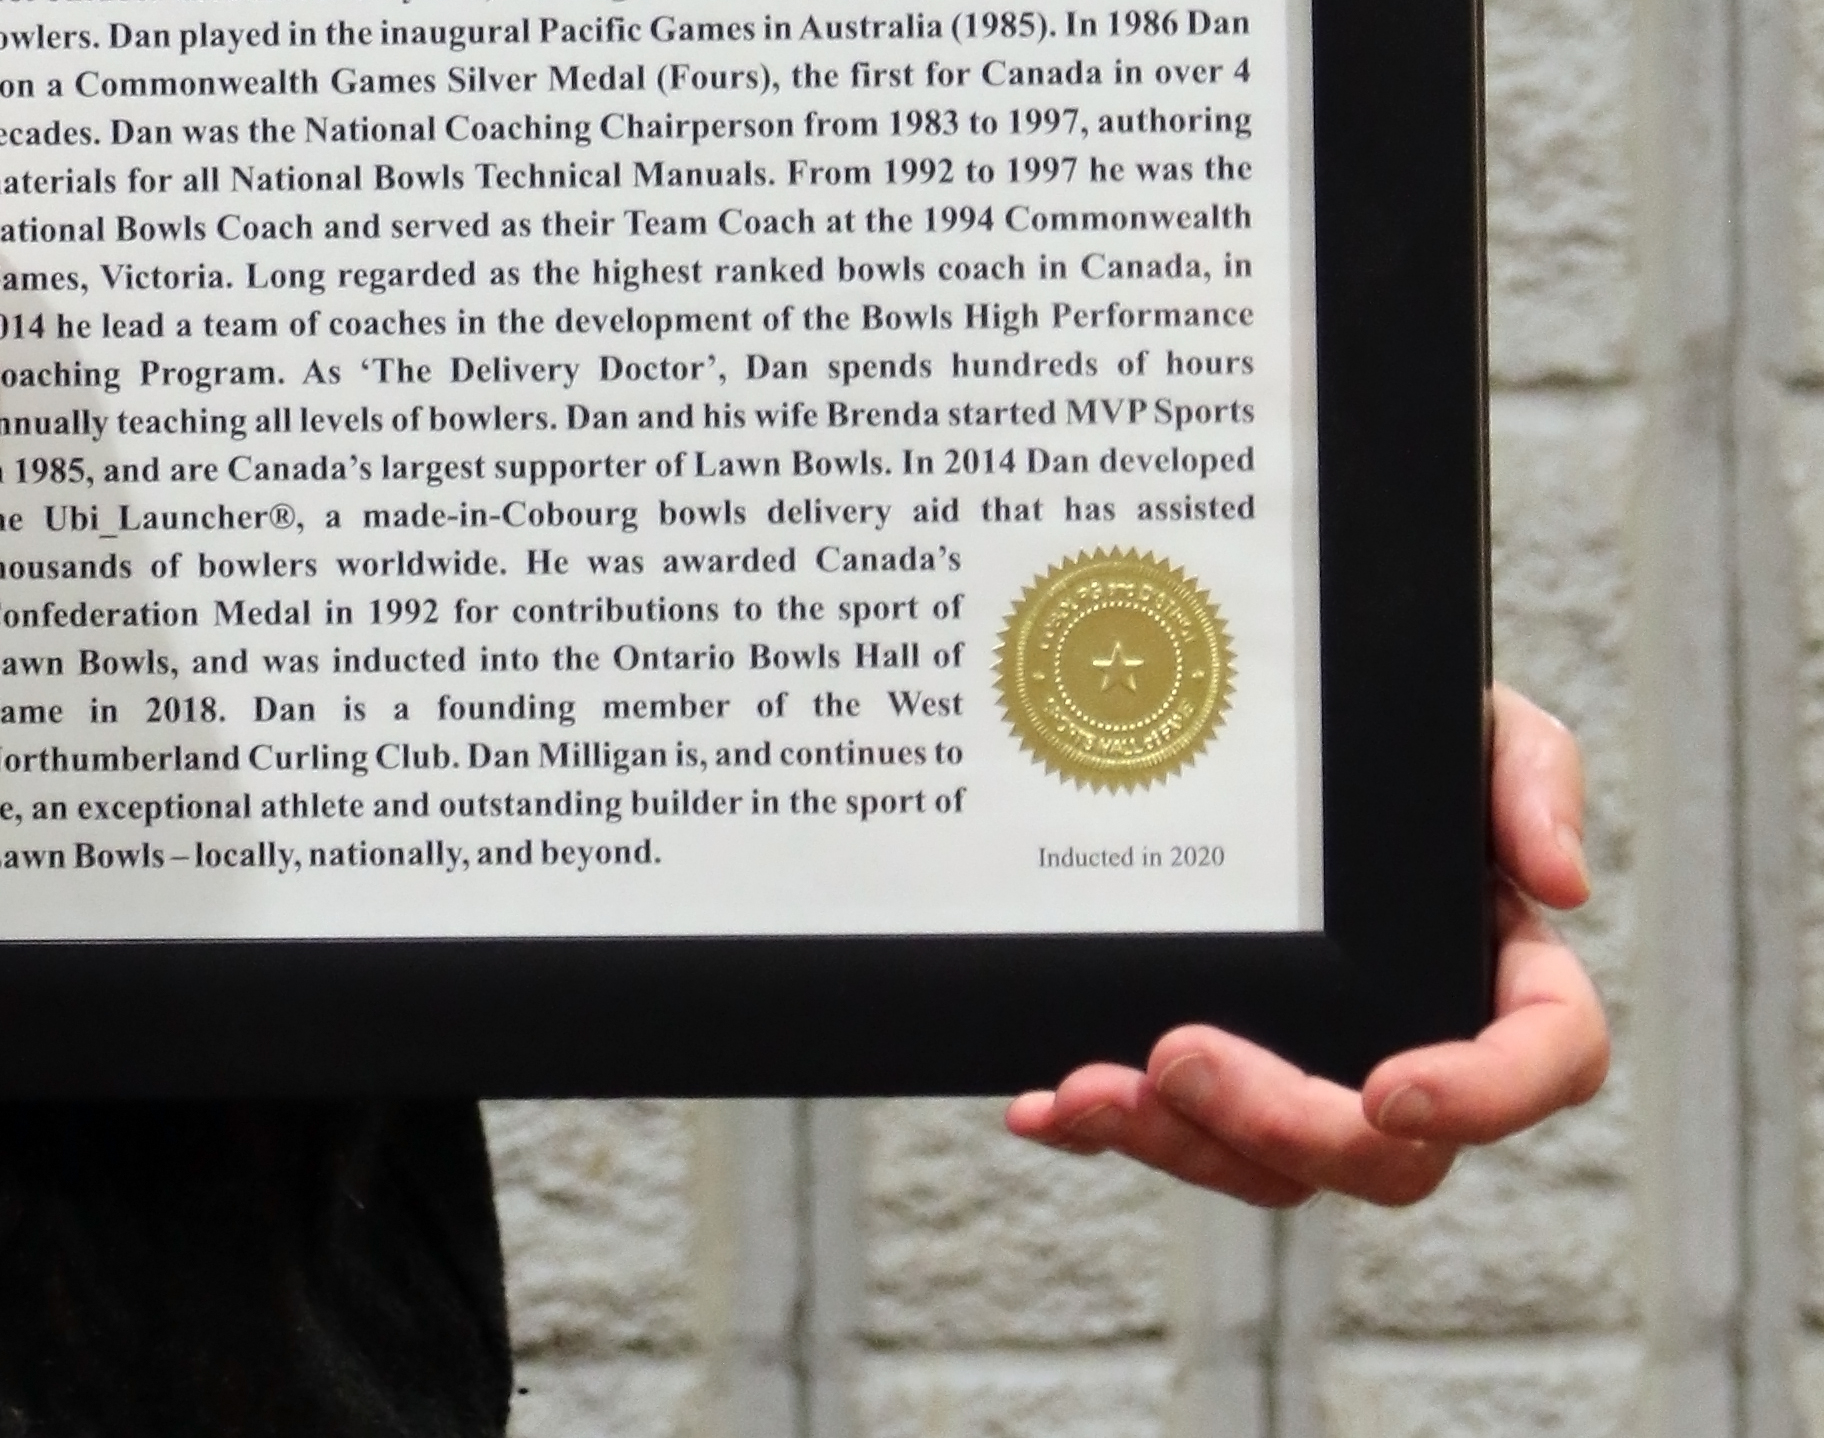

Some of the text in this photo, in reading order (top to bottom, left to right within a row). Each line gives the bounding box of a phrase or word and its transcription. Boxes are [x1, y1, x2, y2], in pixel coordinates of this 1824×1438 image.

[109, 22, 171, 49] Dan
[179, 20, 281, 56] played
[288, 19, 317, 47] in
[325, 19, 373, 46] the
[380, 17, 530, 53] inaugural
[538, 15, 642, 44] Pacific
[649, 15, 756, 43] Games
[763, 13, 792, 41] in
[799, 11, 943, 41] Australia
[951, 11, 1057, 45] (1985).
[1066, 10, 1097, 37] In
[1109, 9, 1179, 37] 1986
[1187, 9, 1250, 36] Dan
[110, 118, 173, 145] Dan
[181, 124, 240, 145] was
[248, 116, 296, 144] the
[304, 115, 436, 143] National
[445, 113, 592, 148] Coaching
[599, 111, 794, 147] Chairperson
[803, 110, 878, 137] from
[890, 108, 959, 137] 1983
[969, 110, 998, 136] to
[1009, 107, 1089, 140] 1997,
[1098, 105, 1252, 140] authoring
[115, 214, 207, 242] Bowls
[216, 213, 313, 241] Coach
[324, 212, 381, 240] and
[391, 211, 490, 240] served
[500, 217, 532, 238] as
[541, 209, 616, 237] their
[623, 209, 707, 236] Team
[718, 207, 816, 236] Coach
[826, 209, 856, 234] at
[864, 206, 913, 234] the
[925, 205, 995, 233] 1994
[1004, 202, 1252, 232] Commonwealth
[140, 359, 285, 394] Program.
[302, 358, 342, 385] As
[450, 355, 580, 390] Delivery
[746, 353, 808, 380] Dan
[827, 351, 932, 387] spends
[952, 350, 1098, 378] hundreds
[1117, 349, 1150, 376] of
[1166, 349, 1254, 376] hours
[325, 509, 342, 529] a
[363, 500, 639, 534] made-in-Cobourg
[658, 498, 747, 526] bowls
[767, 497, 892, 531] delivery
[912, 496, 960, 523] aid
[980, 496, 1044, 523] that
[1064, 495, 1116, 522] has
[1137, 493, 1255, 521] assisted
[150, 551, 183, 579] of
[198, 551, 318, 579] bowlers
[335, 549, 507, 577] worldwide.
[526, 548, 569, 575] He
[586, 555, 644, 575] was
[662, 546, 796, 574] awarded
[78, 648, 179, 680] Bowls,
[192, 647, 249, 675] and
[262, 654, 320, 674] was
[332, 645, 466, 674] inducted
[480, 644, 539, 672] into
[552, 644, 600, 672] the
[612, 642, 736, 671] Ontario
[749, 642, 841, 670] Bowls
[855, 641, 920, 669] Hall
[932, 640, 966, 669] of
[248, 743, 369, 778] Curling
[375, 742, 460, 770] Club.
[467, 742, 530, 769] Dan
[538, 740, 668, 775] Milligan
[675, 740, 708, 772] is,
[715, 739, 772, 767] and
[779, 739, 927, 767] continues
[934, 741, 964, 765] to
[31, 801, 68, 821] an
[77, 792, 251, 828] exceptional
[261, 791, 365, 819] athlete
[373, 790, 430, 818] and
[439, 789, 623, 824] outstanding
[631, 788, 744, 817] builder
[751, 787, 780, 815] in
[789, 787, 837, 815] the
[845, 789, 926, 815] sport
[934, 785, 968, 814] of
[1038, 844, 1227, 868] Inducted in 2020
